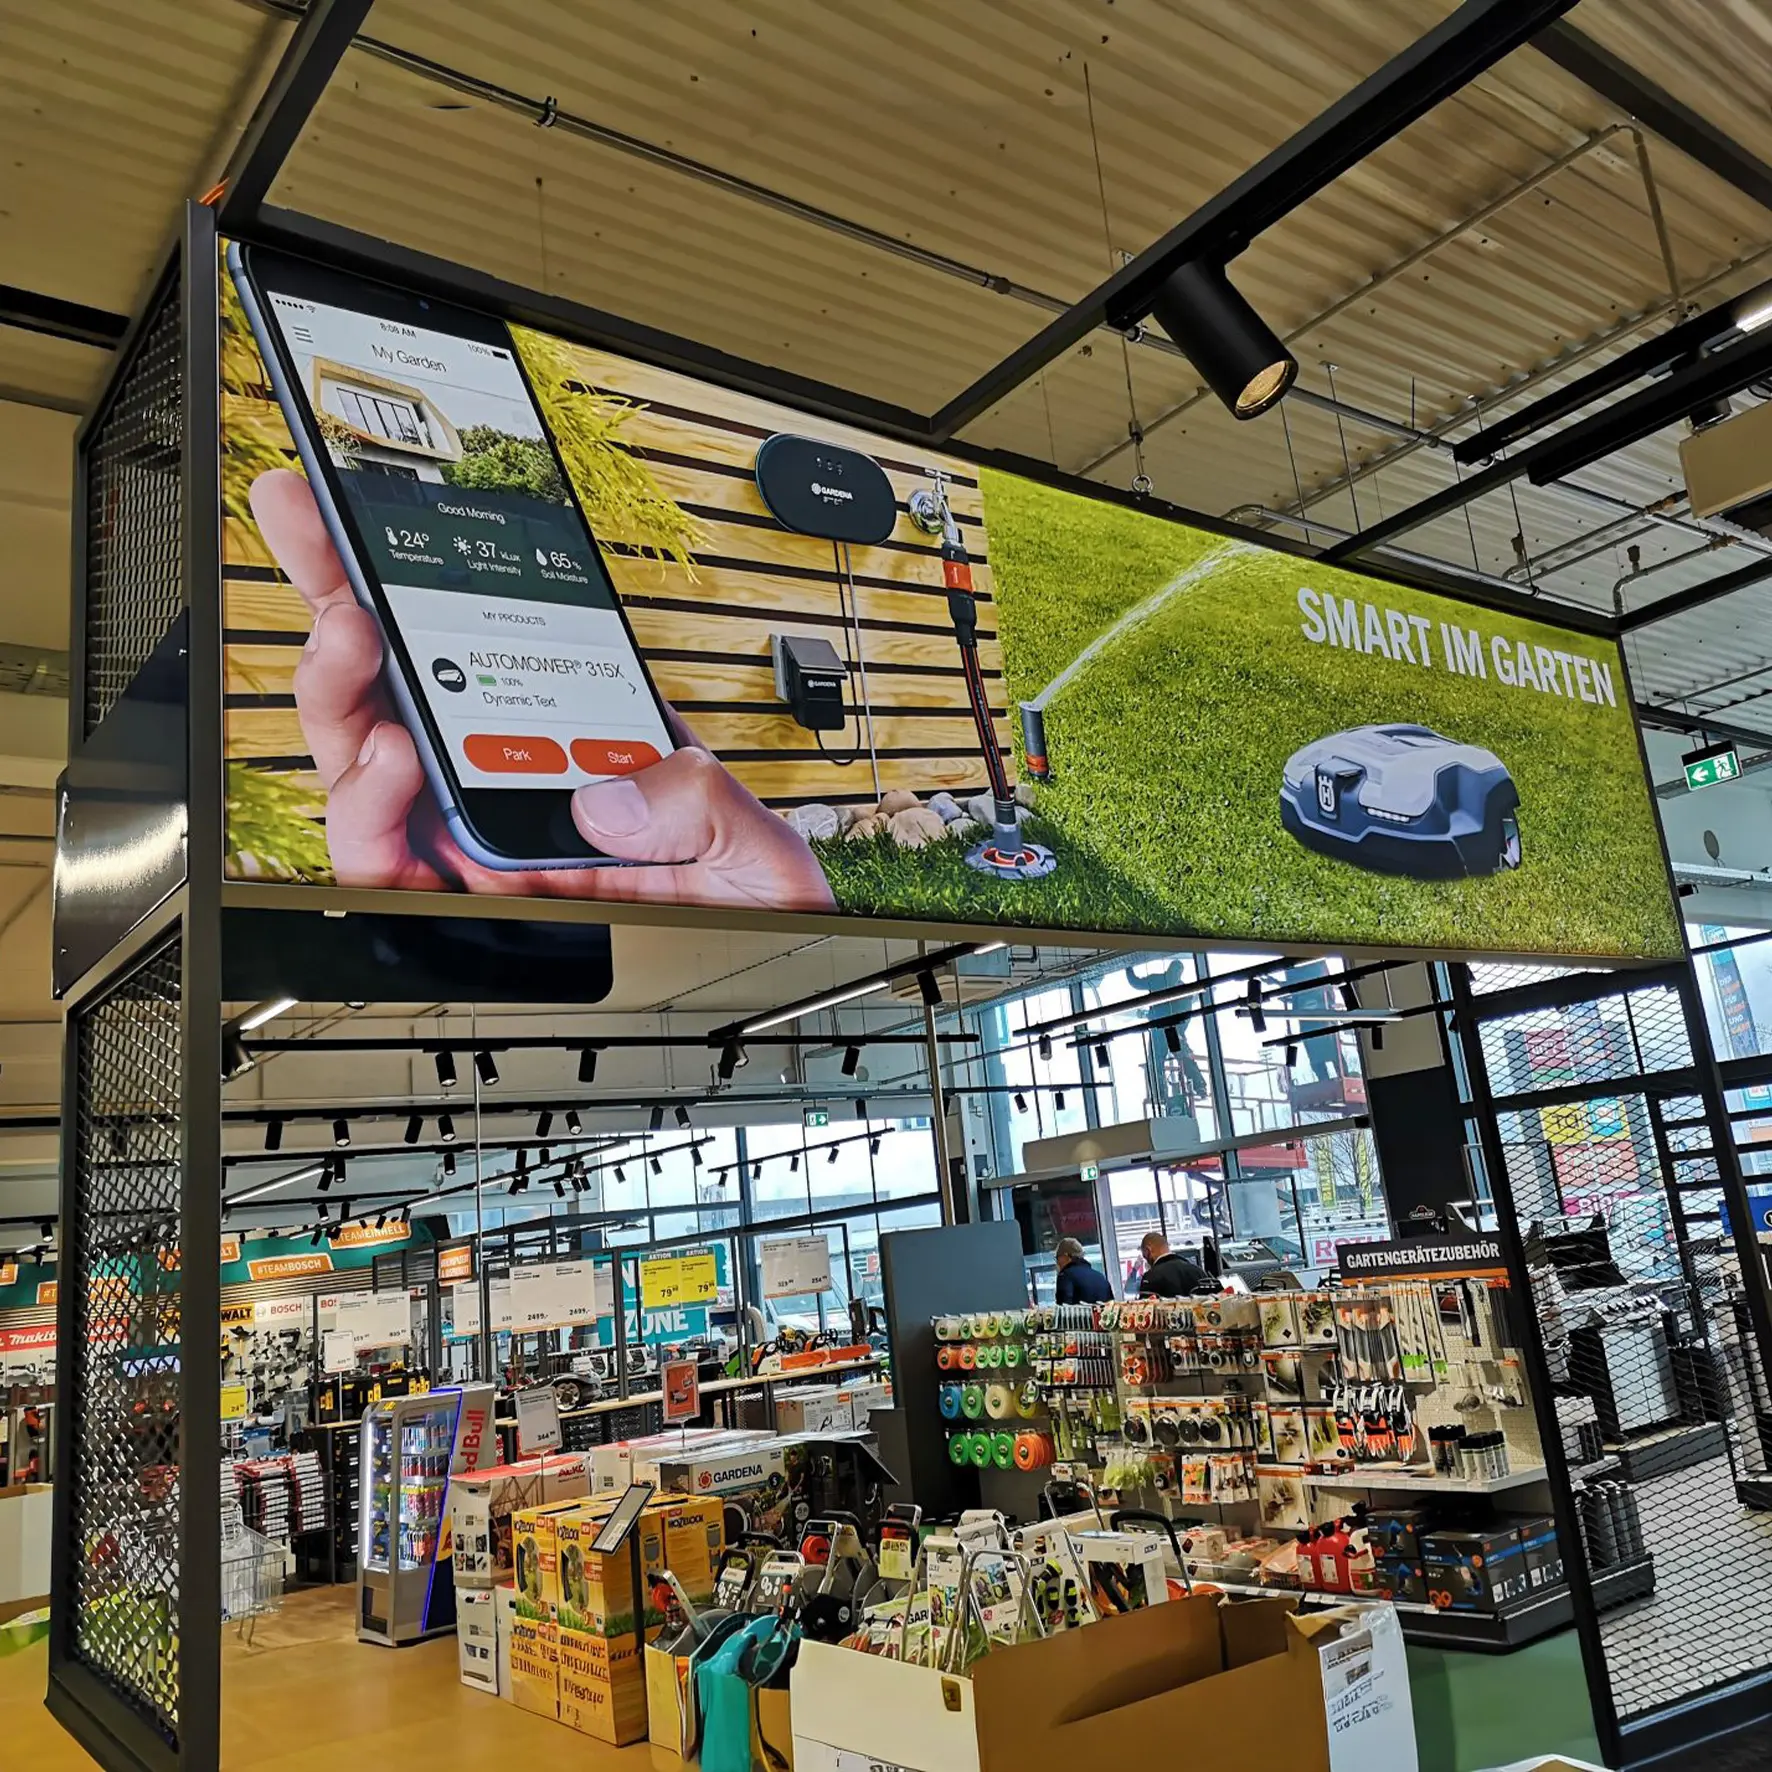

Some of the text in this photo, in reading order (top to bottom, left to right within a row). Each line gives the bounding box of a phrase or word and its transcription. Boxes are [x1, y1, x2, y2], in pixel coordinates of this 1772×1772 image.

[402, 328, 417, 339] AM
[371, 344, 447, 373] My Garden
[467, 343, 491, 357] 100%
[821, 486, 853, 500] GARDENA
[437, 502, 506, 525] Good Morning
[389, 549, 445, 566] Temperature
[476, 540, 496, 558] 37
[467, 559, 522, 577] Light Intensity
[550, 551, 572, 569] 65
[541, 569, 589, 585] Soil Moisture
[482, 611, 547, 627] MY PRODUCTS
[1297, 587, 1617, 708] SMART IM GARTEN
[585, 661, 626, 680] 315X
[500, 677, 524, 688] 100%
[481, 692, 558, 708] Dynamic Text
[502, 747, 635, 765] Park Start
[333, 1222, 405, 1243] TEAMEINHELL
[1346, 1241, 1501, 1269] GARTENGERÄTEZUBEHÖR
[257, 1258, 322, 1275] #TEAMBOSCH
[270, 1303, 302, 1315] BOSCH
[624, 1309, 689, 1338] ZONE
[463, 1409, 486, 1449] Bull
[713, 1464, 763, 1484] GARDENA
[907, 1609, 929, 1625] GAR
